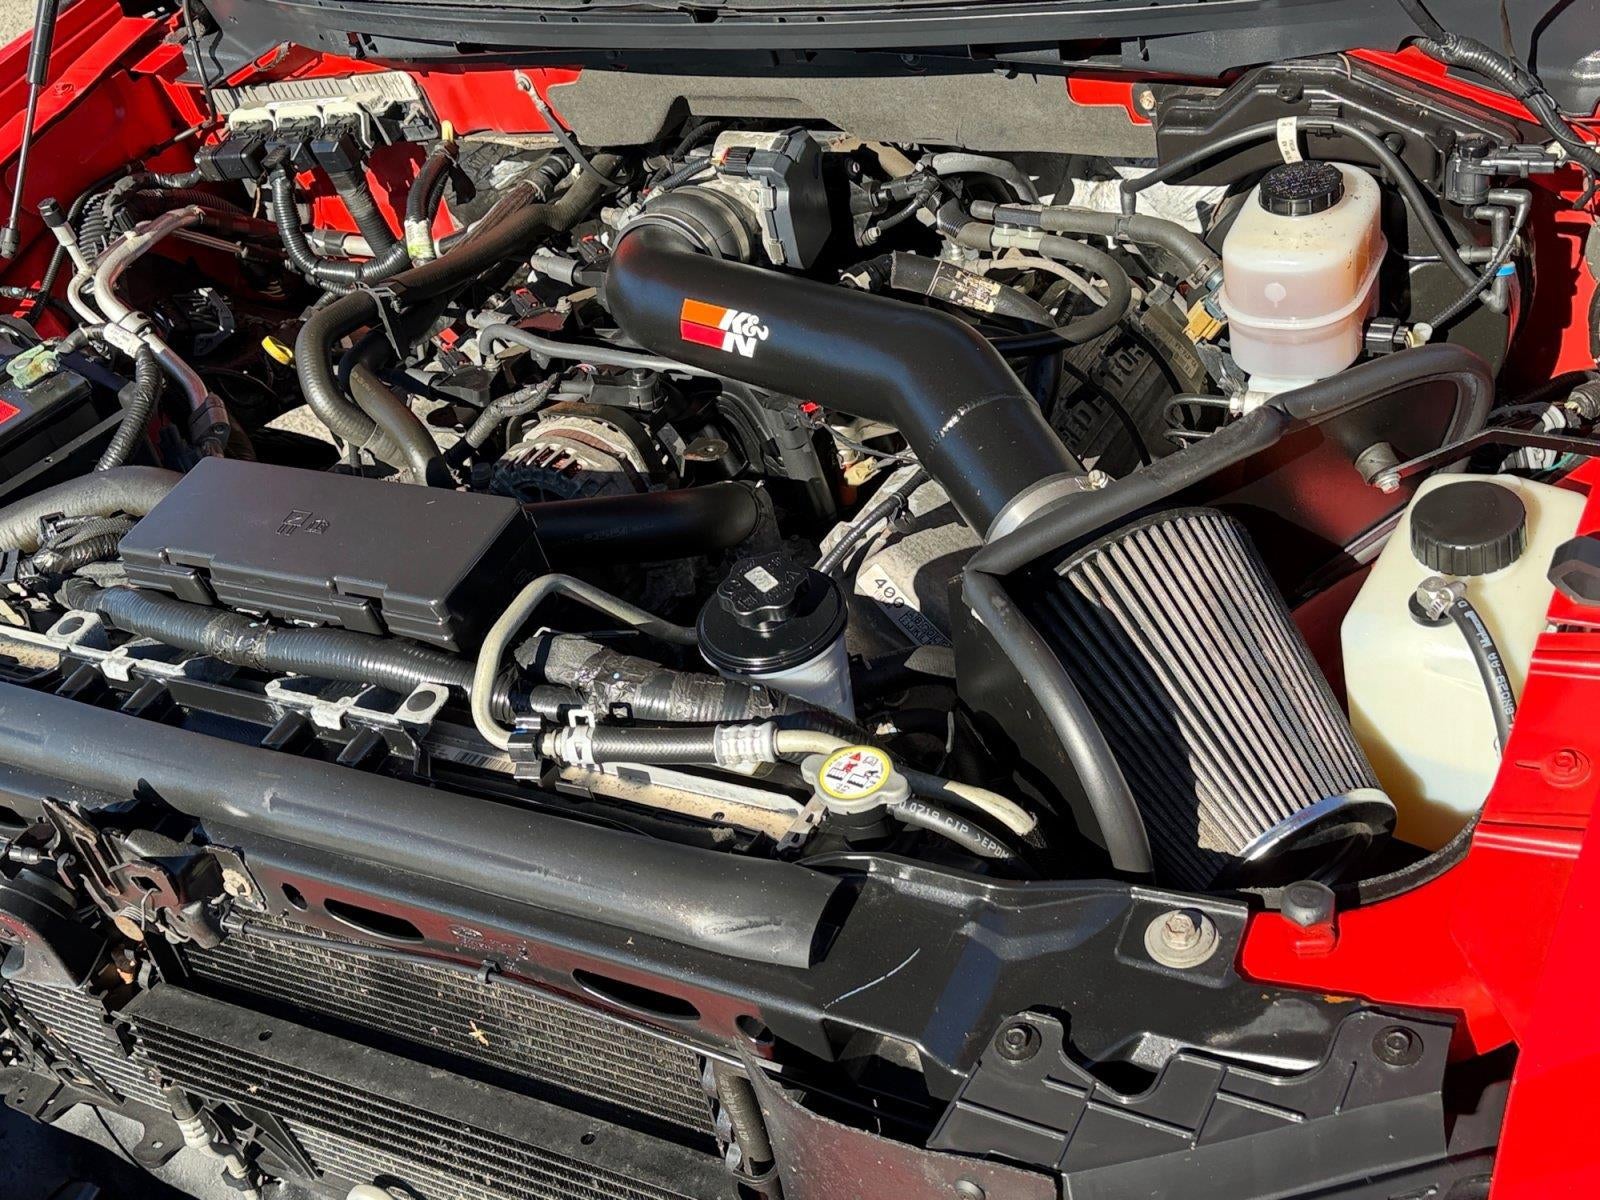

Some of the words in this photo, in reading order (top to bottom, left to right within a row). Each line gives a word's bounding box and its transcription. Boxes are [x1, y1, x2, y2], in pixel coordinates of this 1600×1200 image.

[719, 308, 769, 358] K&N
[874, 579, 905, 608] 400
[945, 817, 969, 833] CIP
